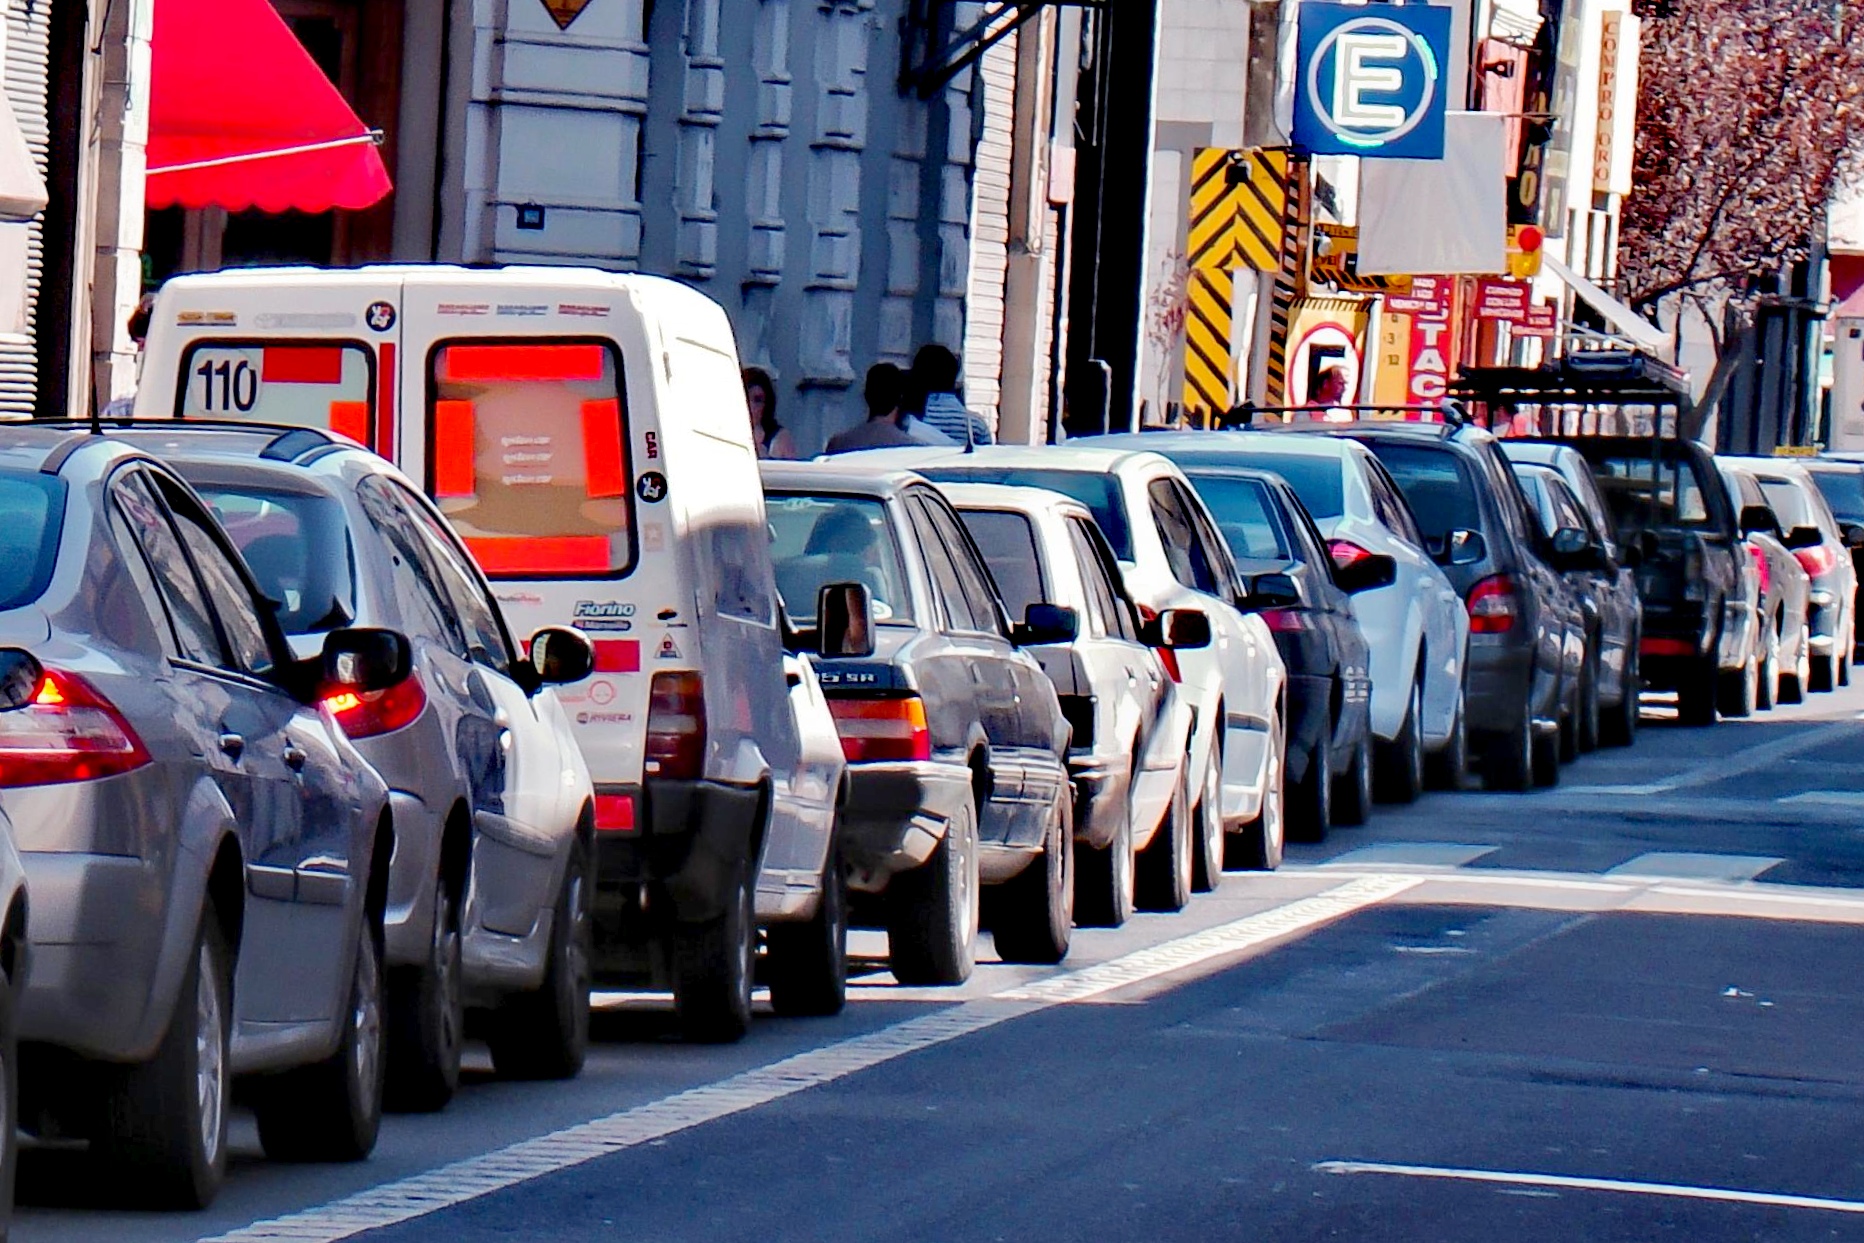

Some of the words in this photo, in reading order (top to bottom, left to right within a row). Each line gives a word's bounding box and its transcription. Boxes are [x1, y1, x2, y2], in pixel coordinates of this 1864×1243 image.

[1333, 33, 1407, 127] E
[1600, 21, 1619, 121] COMPRO
[1595, 131, 1611, 182] ORO
[197, 360, 257, 412] 110
[645, 432, 658, 459] CAR
[573, 600, 636, 617] Fiorino
